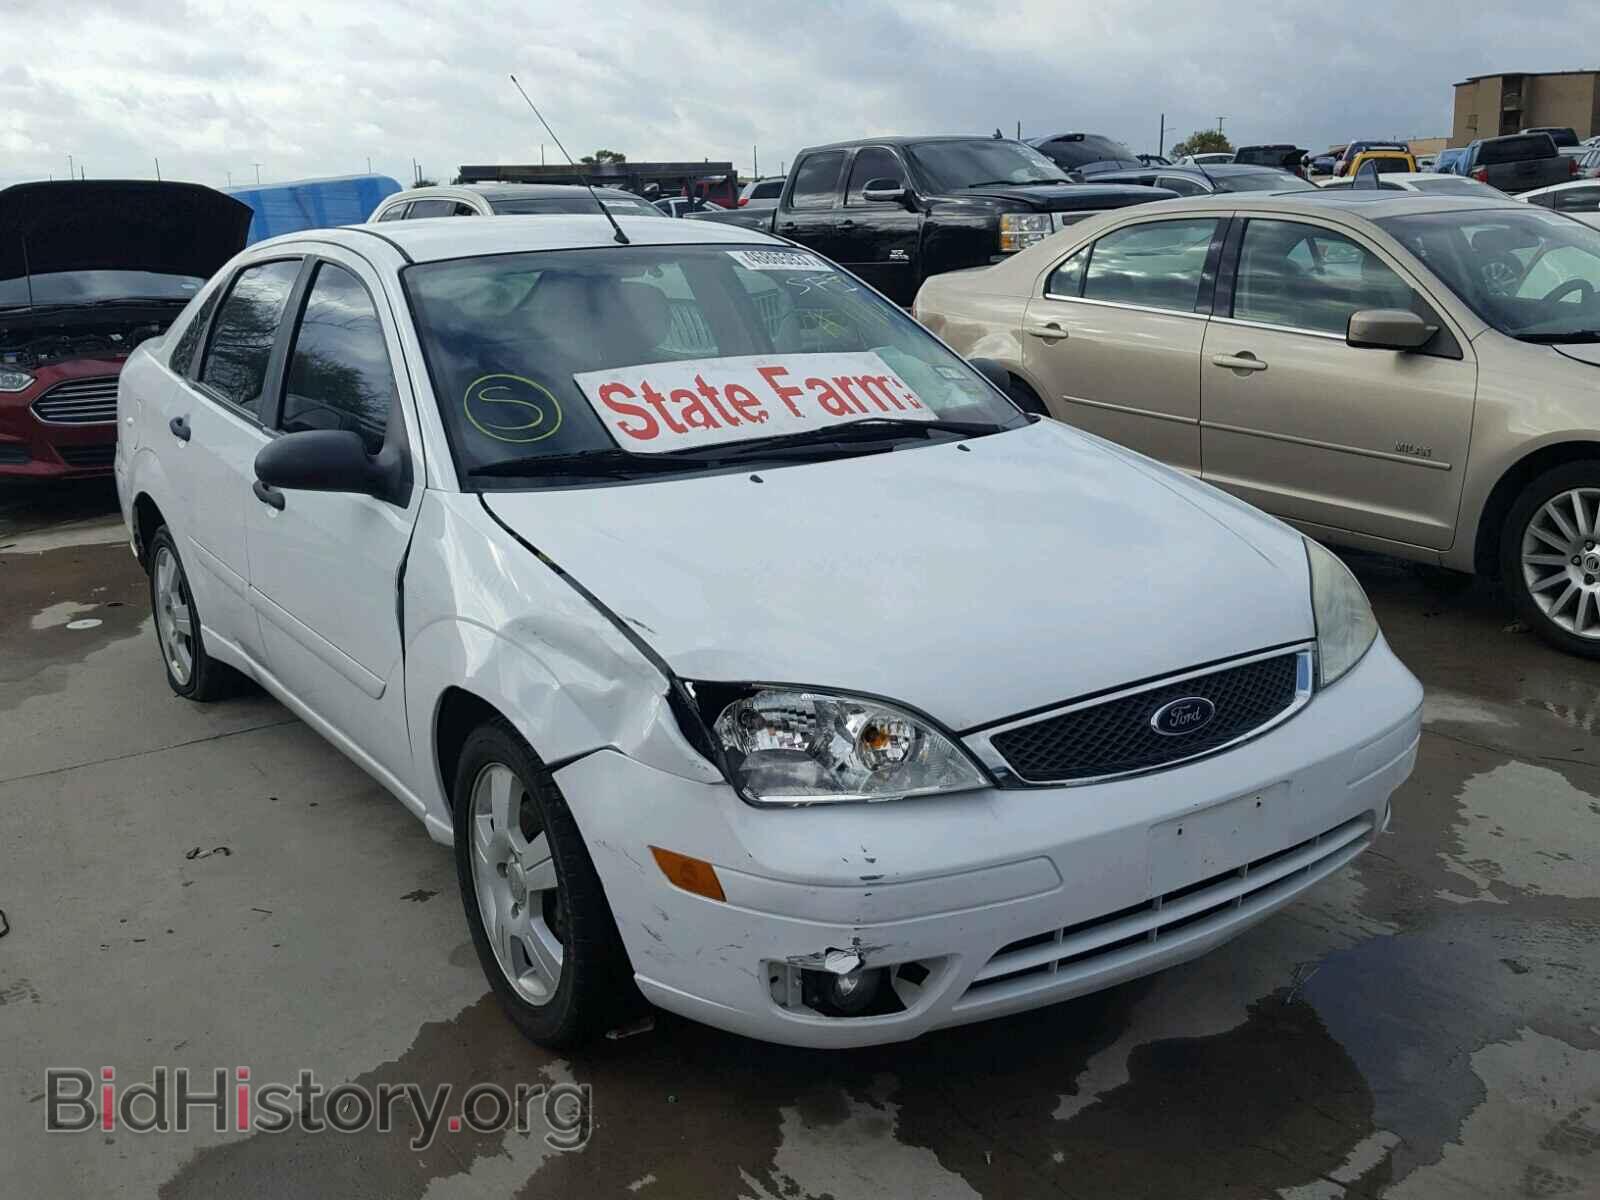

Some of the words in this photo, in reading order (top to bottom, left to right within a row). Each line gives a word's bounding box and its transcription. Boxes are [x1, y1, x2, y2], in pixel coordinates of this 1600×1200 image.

[478, 386, 543, 430] S
[599, 373, 769, 441] State
[757, 366, 923, 418] Farm
[1169, 703, 1202, 727] Ford
